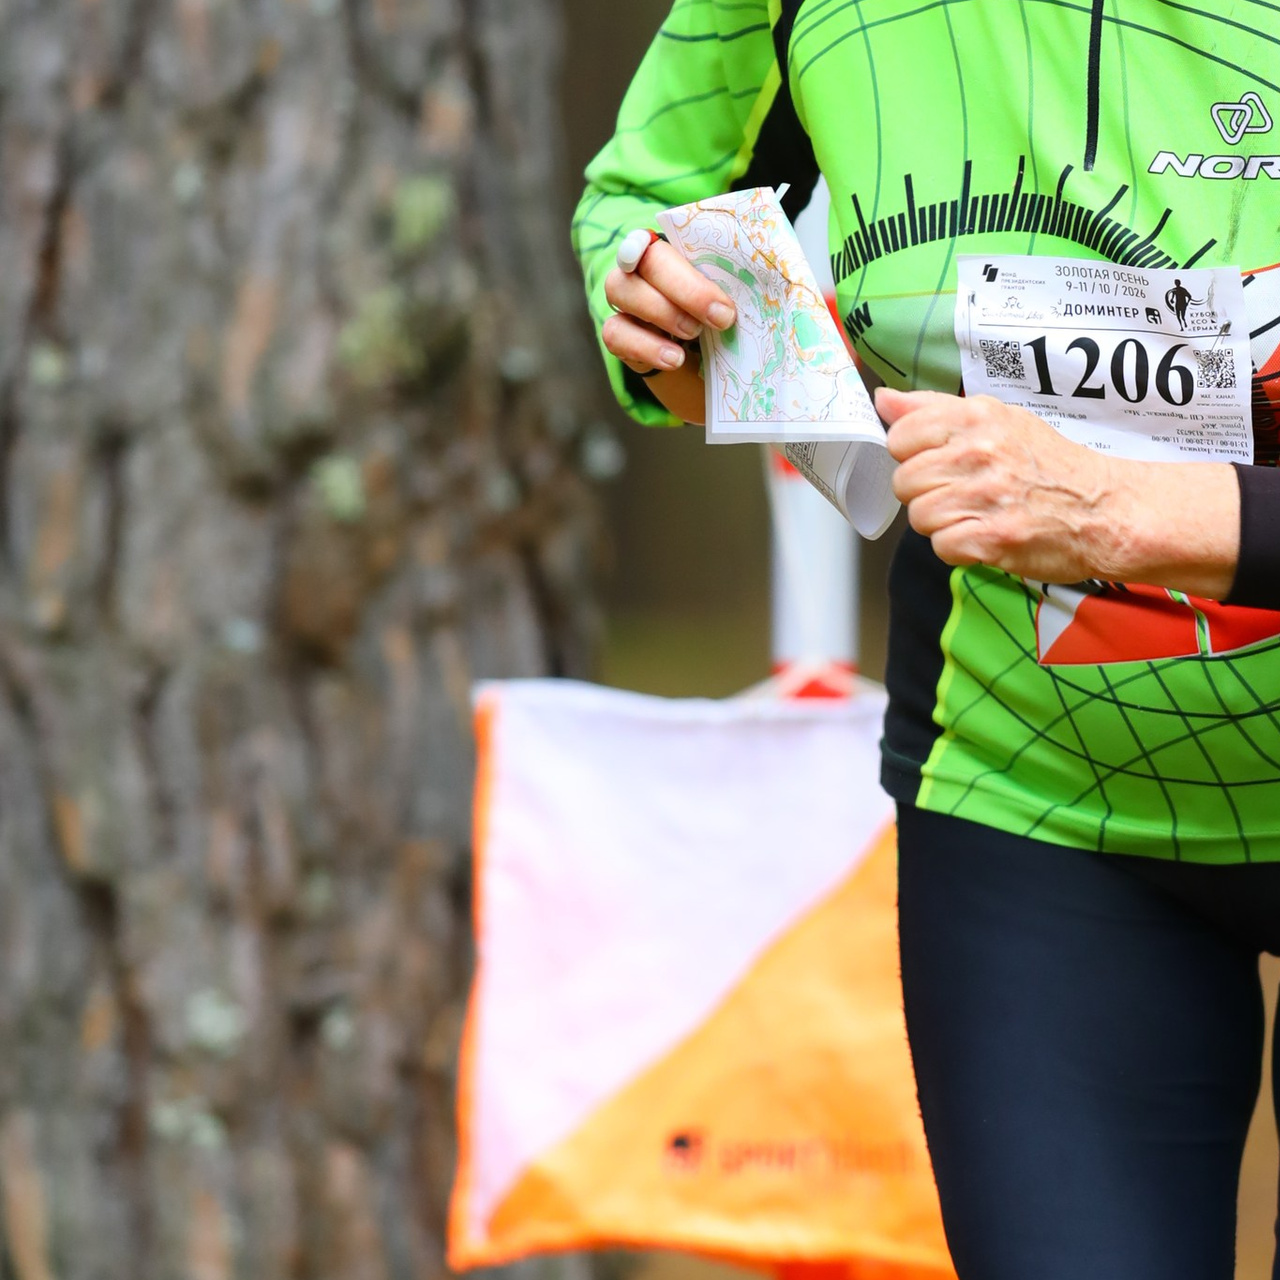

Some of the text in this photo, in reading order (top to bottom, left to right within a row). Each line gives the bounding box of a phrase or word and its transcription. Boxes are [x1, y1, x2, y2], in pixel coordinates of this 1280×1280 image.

[1055, 265, 1150, 286] ЗОЛОТАЯ ОСЕНЬ
[1098, 283, 1111, 295] 10
[1122, 285, 1146, 298] 2026
[1063, 303, 1139, 318] ДОМИНТЕР
[1024, 335, 1194, 407] 1206
